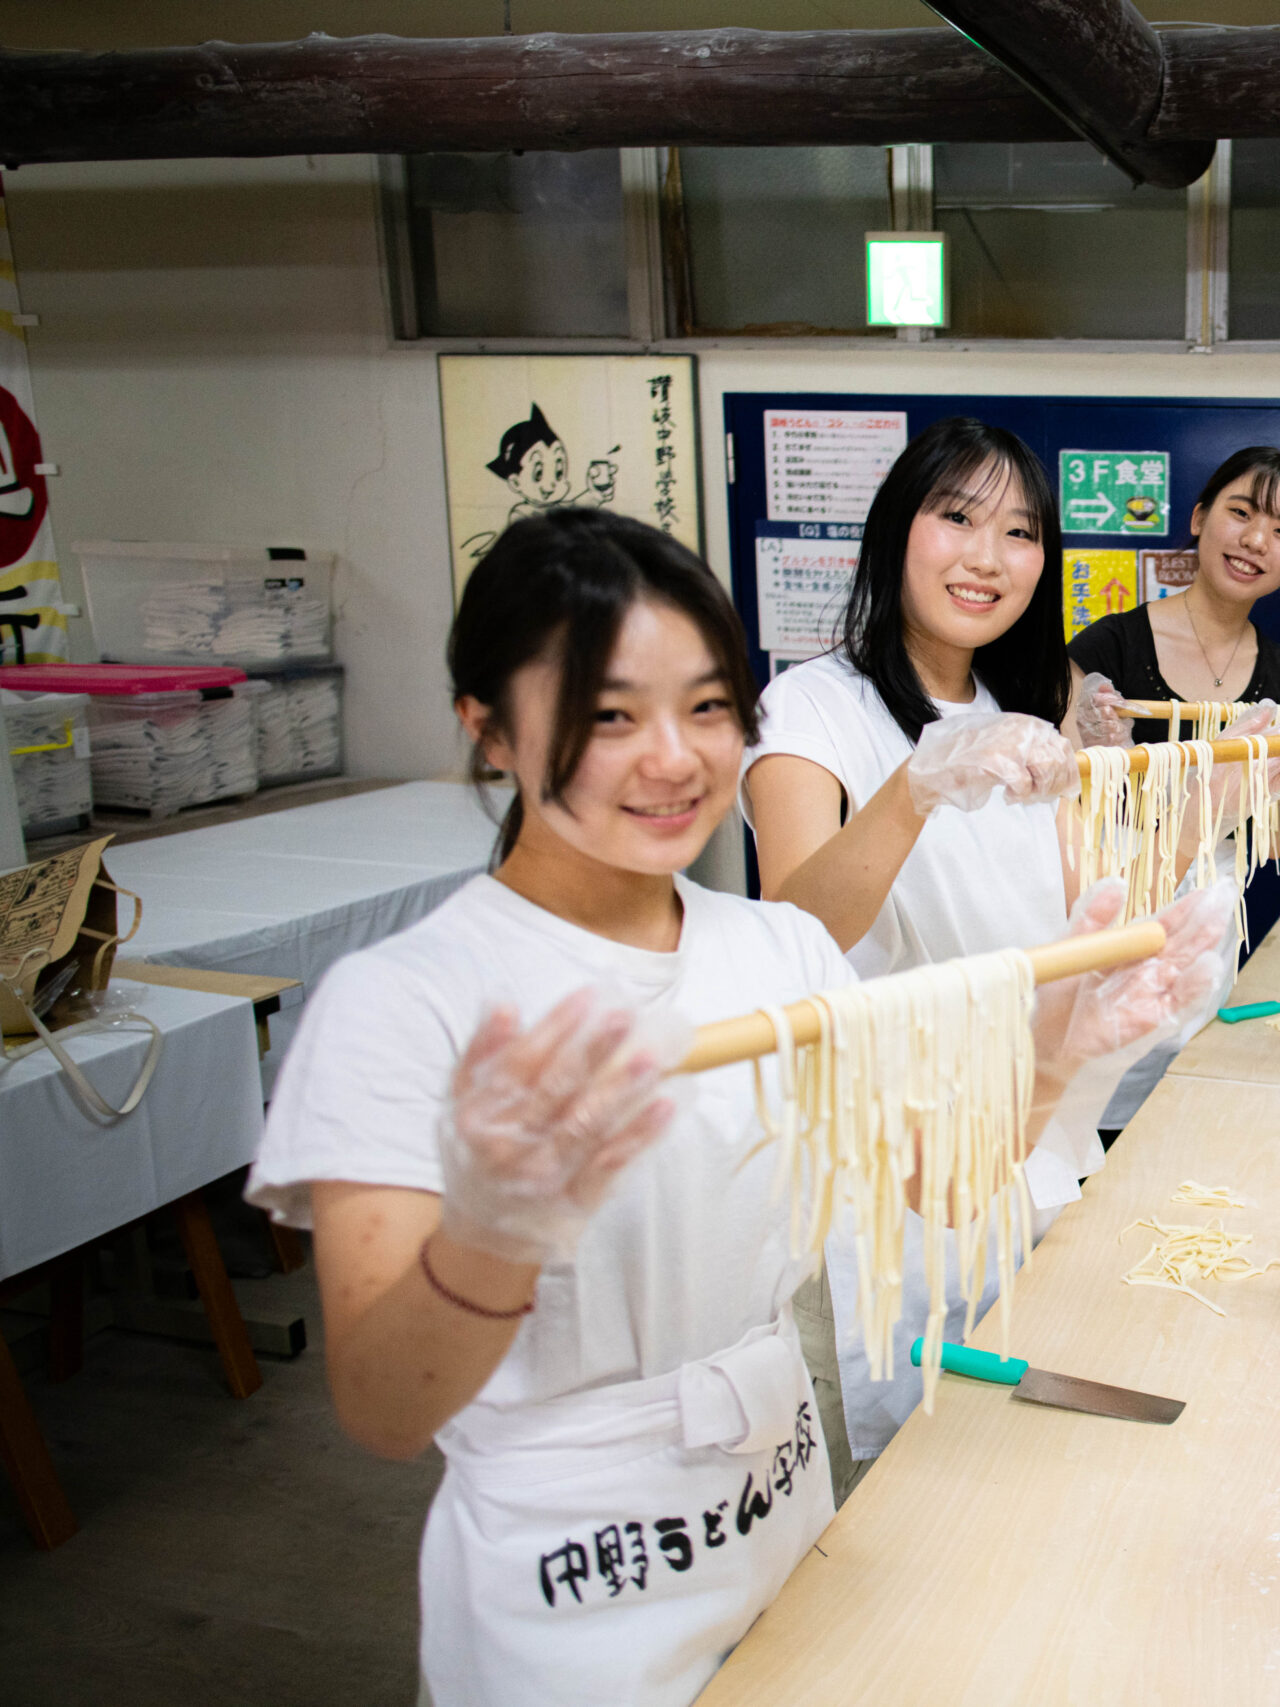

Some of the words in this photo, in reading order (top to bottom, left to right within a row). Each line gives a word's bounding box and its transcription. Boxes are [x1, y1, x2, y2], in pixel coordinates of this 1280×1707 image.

[1068, 459, 1165, 486] 3F食堂
[540, 1401, 817, 1608] 中野うどん学校
